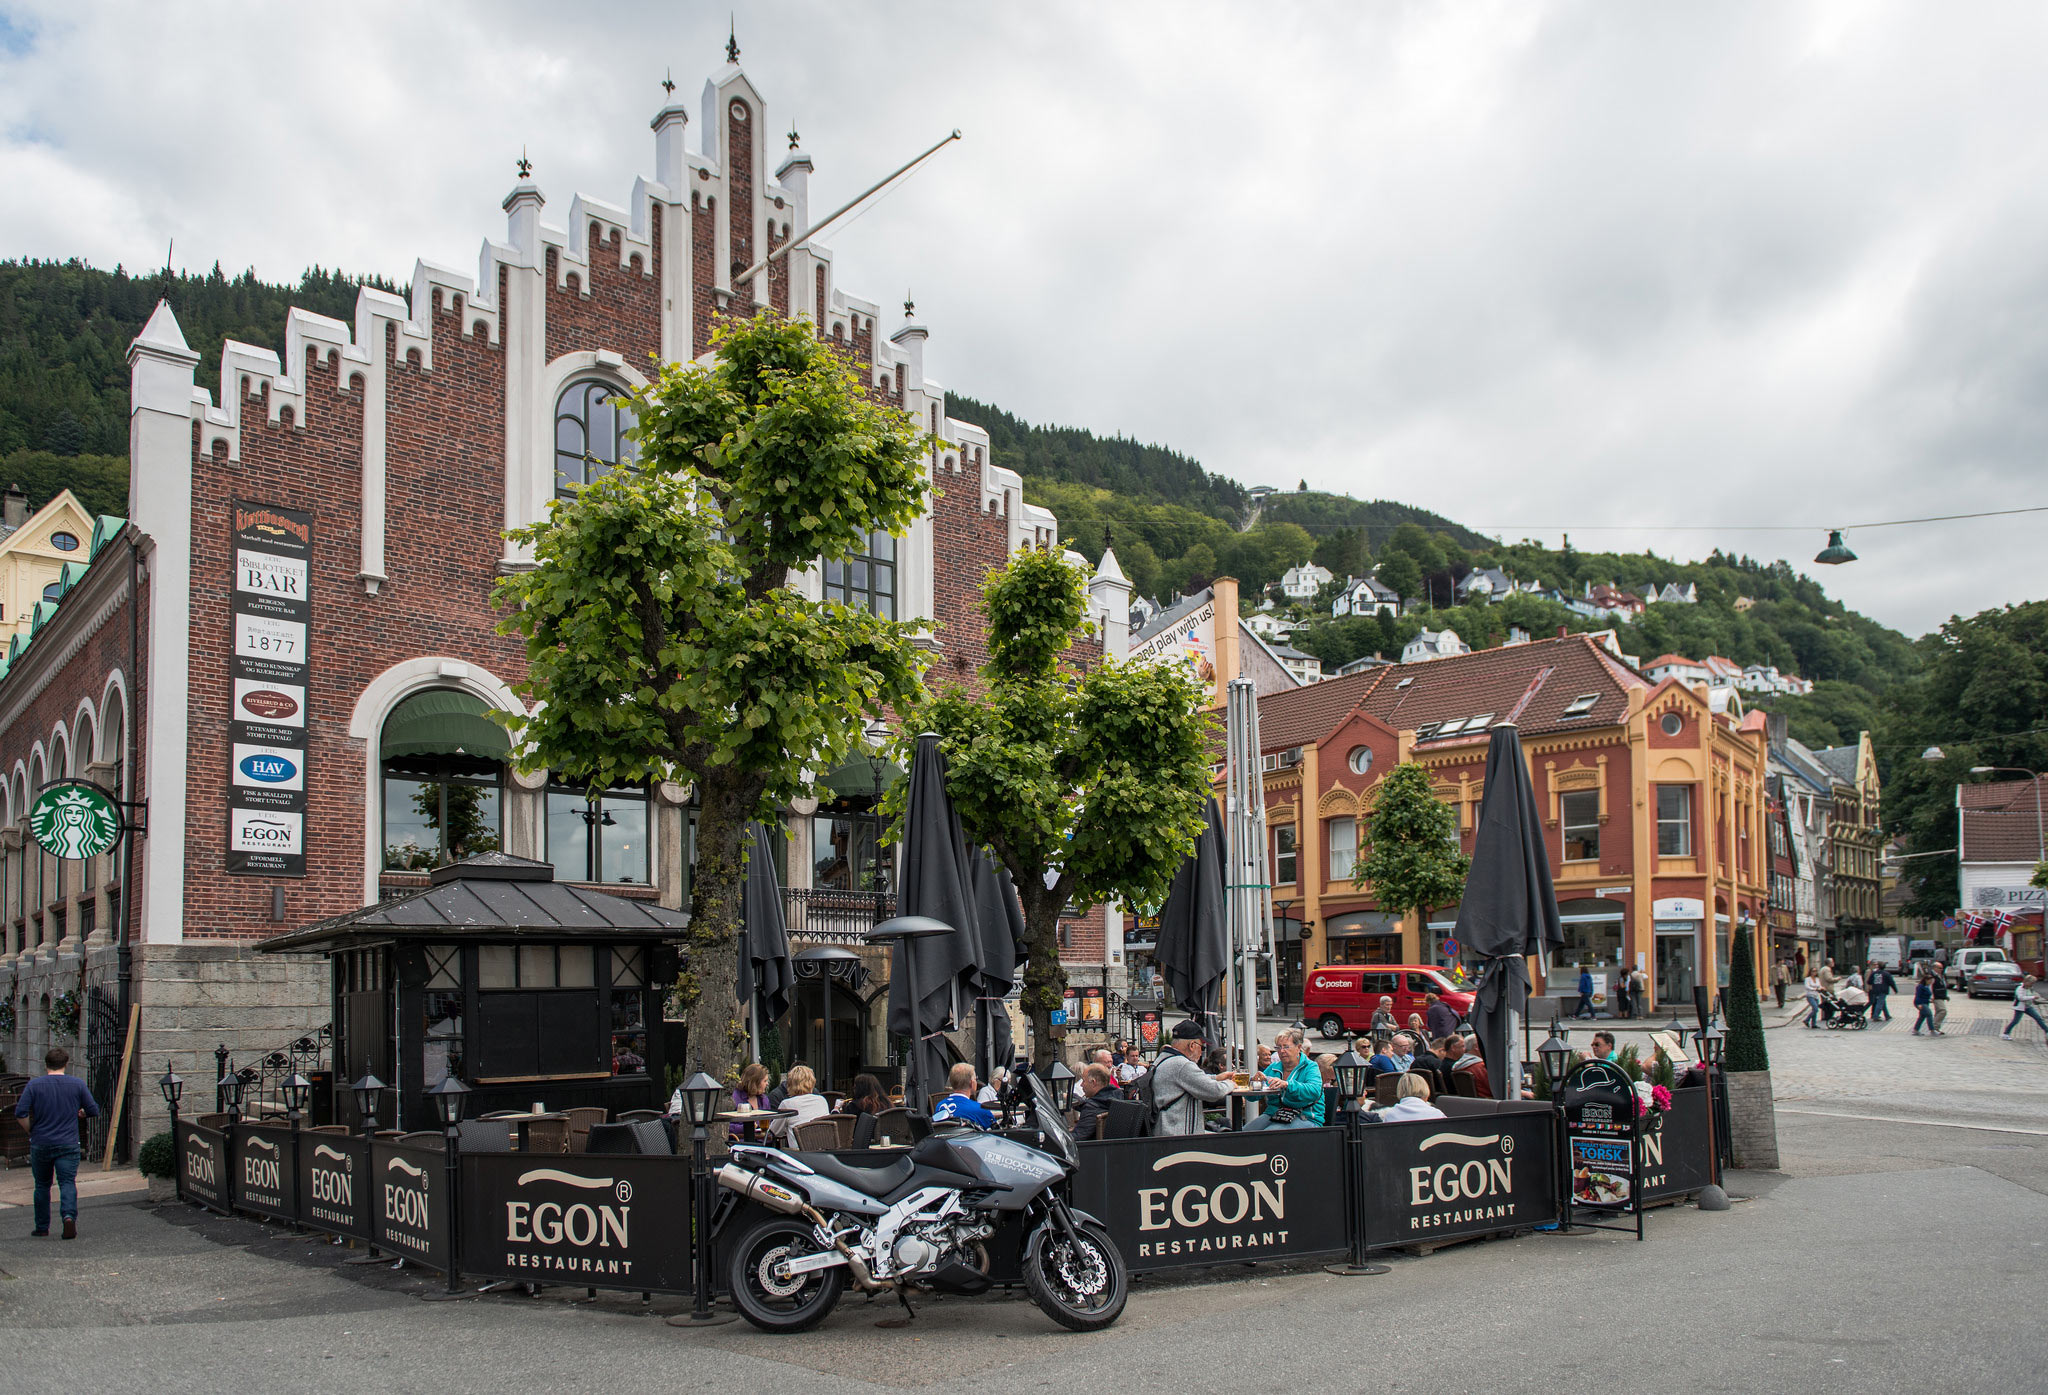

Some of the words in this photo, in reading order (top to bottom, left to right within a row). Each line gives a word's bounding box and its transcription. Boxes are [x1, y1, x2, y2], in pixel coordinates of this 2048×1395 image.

[239, 557, 304, 577] BIBLIOTEKET
[248, 570, 297, 594] BAR
[258, 598, 286, 607] BERGENS
[284, 607, 296, 615] BAR
[247, 626, 295, 639] Restaurant
[1156, 630, 1177, 653] play
[1177, 615, 1200, 636] with
[1199, 603, 1215, 622] us!
[248, 635, 295, 654] 1877
[269, 663, 302, 672] KUNNSKAP
[252, 760, 285, 774] HAV
[262, 791, 293, 799] SKALLDYR
[242, 827, 291, 841] EGON
[247, 861, 287, 869] RESTAURANT
[250, 855, 284, 863] UFORMELL
[793, 960, 872, 991] GON
[1326, 980, 1353, 989] posten
[1579, 1147, 1623, 1161] TORSK
[187, 1151, 215, 1186] EGON
[245, 1156, 280, 1190] EGON
[189, 1182, 218, 1200] RESTAURANT
[312, 1168, 352, 1206] EGON
[1409, 1157, 1512, 1205] EGON
[245, 1191, 281, 1207] RESTAURANT
[385, 1183, 428, 1230] EGON
[1138, 1179, 1286, 1231] EGON
[312, 1206, 354, 1226] RESTAURANT
[506, 1201, 630, 1248] EGON
[1411, 1203, 1515, 1229] RESTAURANT
[386, 1228, 430, 1253] RESTAURANT
[1139, 1230, 1289, 1257] RESTAURANT
[507, 1253, 632, 1275] RESTAURANT
